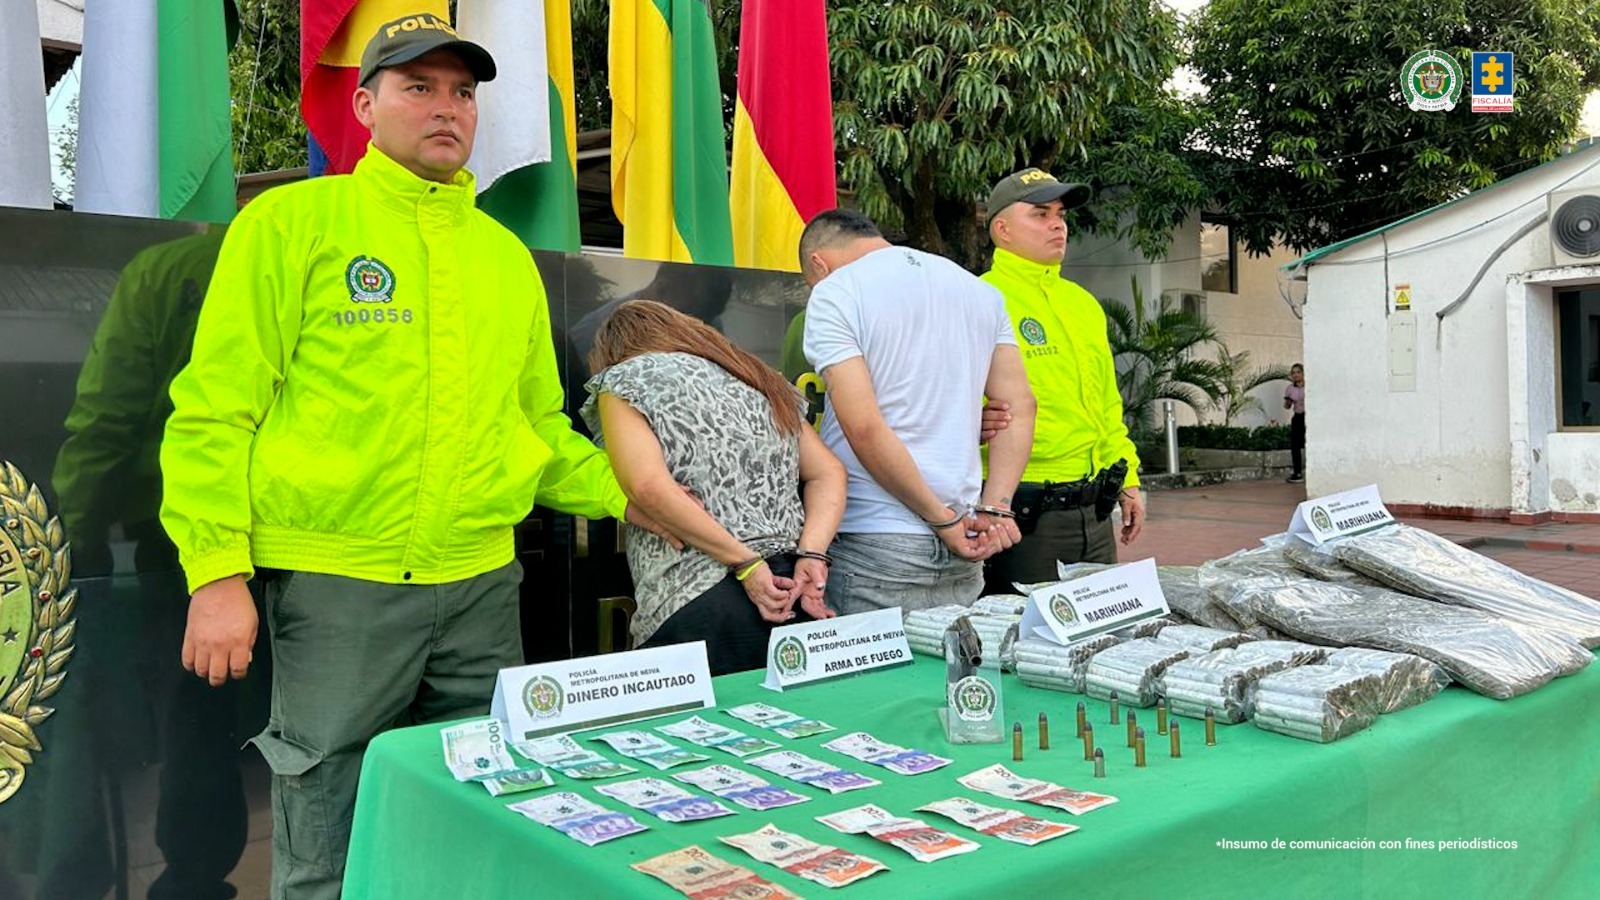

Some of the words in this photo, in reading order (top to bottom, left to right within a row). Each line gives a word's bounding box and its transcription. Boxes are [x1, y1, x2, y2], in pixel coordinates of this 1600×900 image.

[332, 308, 413, 327] 100858
[1336, 510, 1387, 530] MARIHUANA
[1084, 598, 1143, 623] MARIHUANA
[807, 629, 837, 641] POLICÍA
[808, 637, 871, 654] METROPOLITANA
[872, 633, 882, 642] DE
[883, 630, 905, 640] NEIVA
[824, 658, 854, 673] ARMA
[854, 654, 869, 666] DE
[871, 648, 903, 663] FUEGO
[569, 668, 598, 679] POLICÍA
[570, 672, 629, 687] METROPOLITANA
[629, 670, 640, 678] DE
[640, 667, 661, 676] NEIVA
[567, 685, 620, 704] DINERO
[622, 673, 696, 695] INCAUTADO
[488, 721, 500, 743] 100
